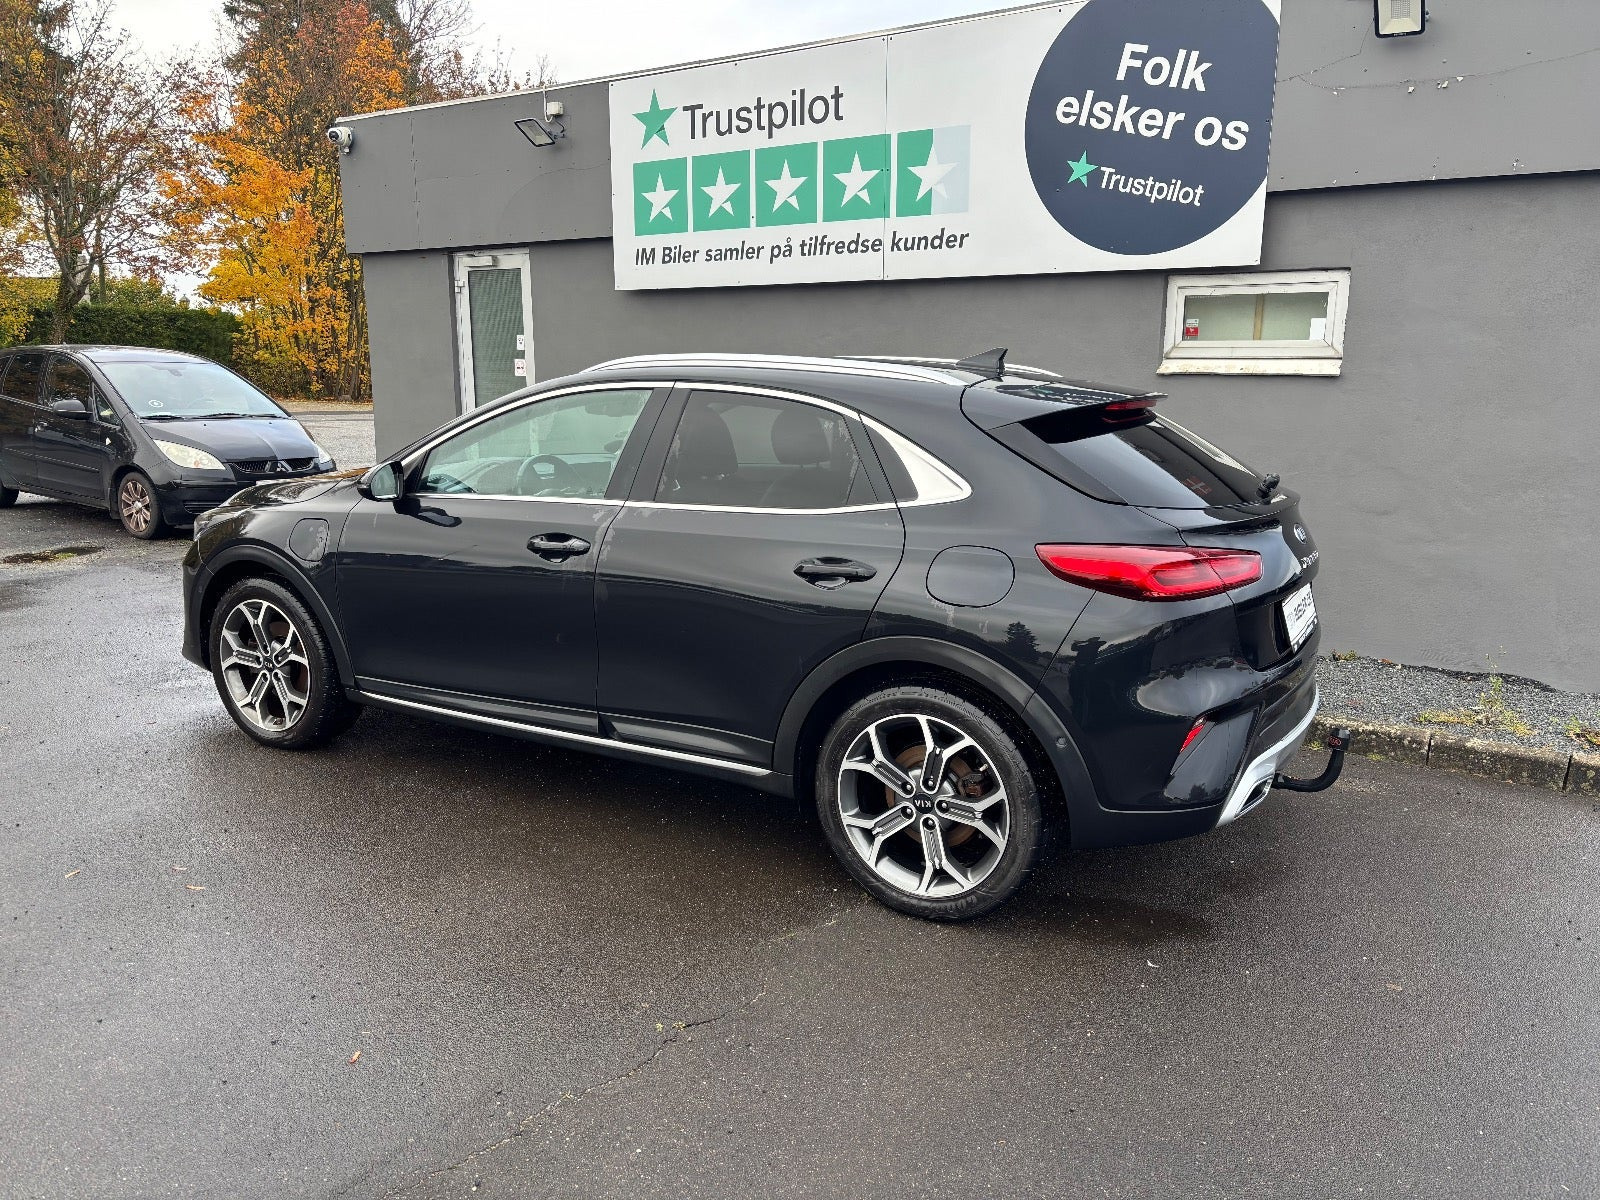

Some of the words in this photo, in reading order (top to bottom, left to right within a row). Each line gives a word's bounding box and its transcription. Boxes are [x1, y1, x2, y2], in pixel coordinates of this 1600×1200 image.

[1116, 42, 1213, 92] Folk
[682, 85, 844, 139] Trustpilot
[1055, 89, 1186, 140] elsker
[1194, 116, 1249, 151] os
[1099, 166, 1204, 207] Trustpilot
[635, 247, 656, 266] IM
[661, 245, 699, 266] Biler
[704, 240, 764, 262] samler
[769, 237, 793, 264] på
[799, 233, 883, 257] tilfredse
[890, 228, 970, 252] kunder
